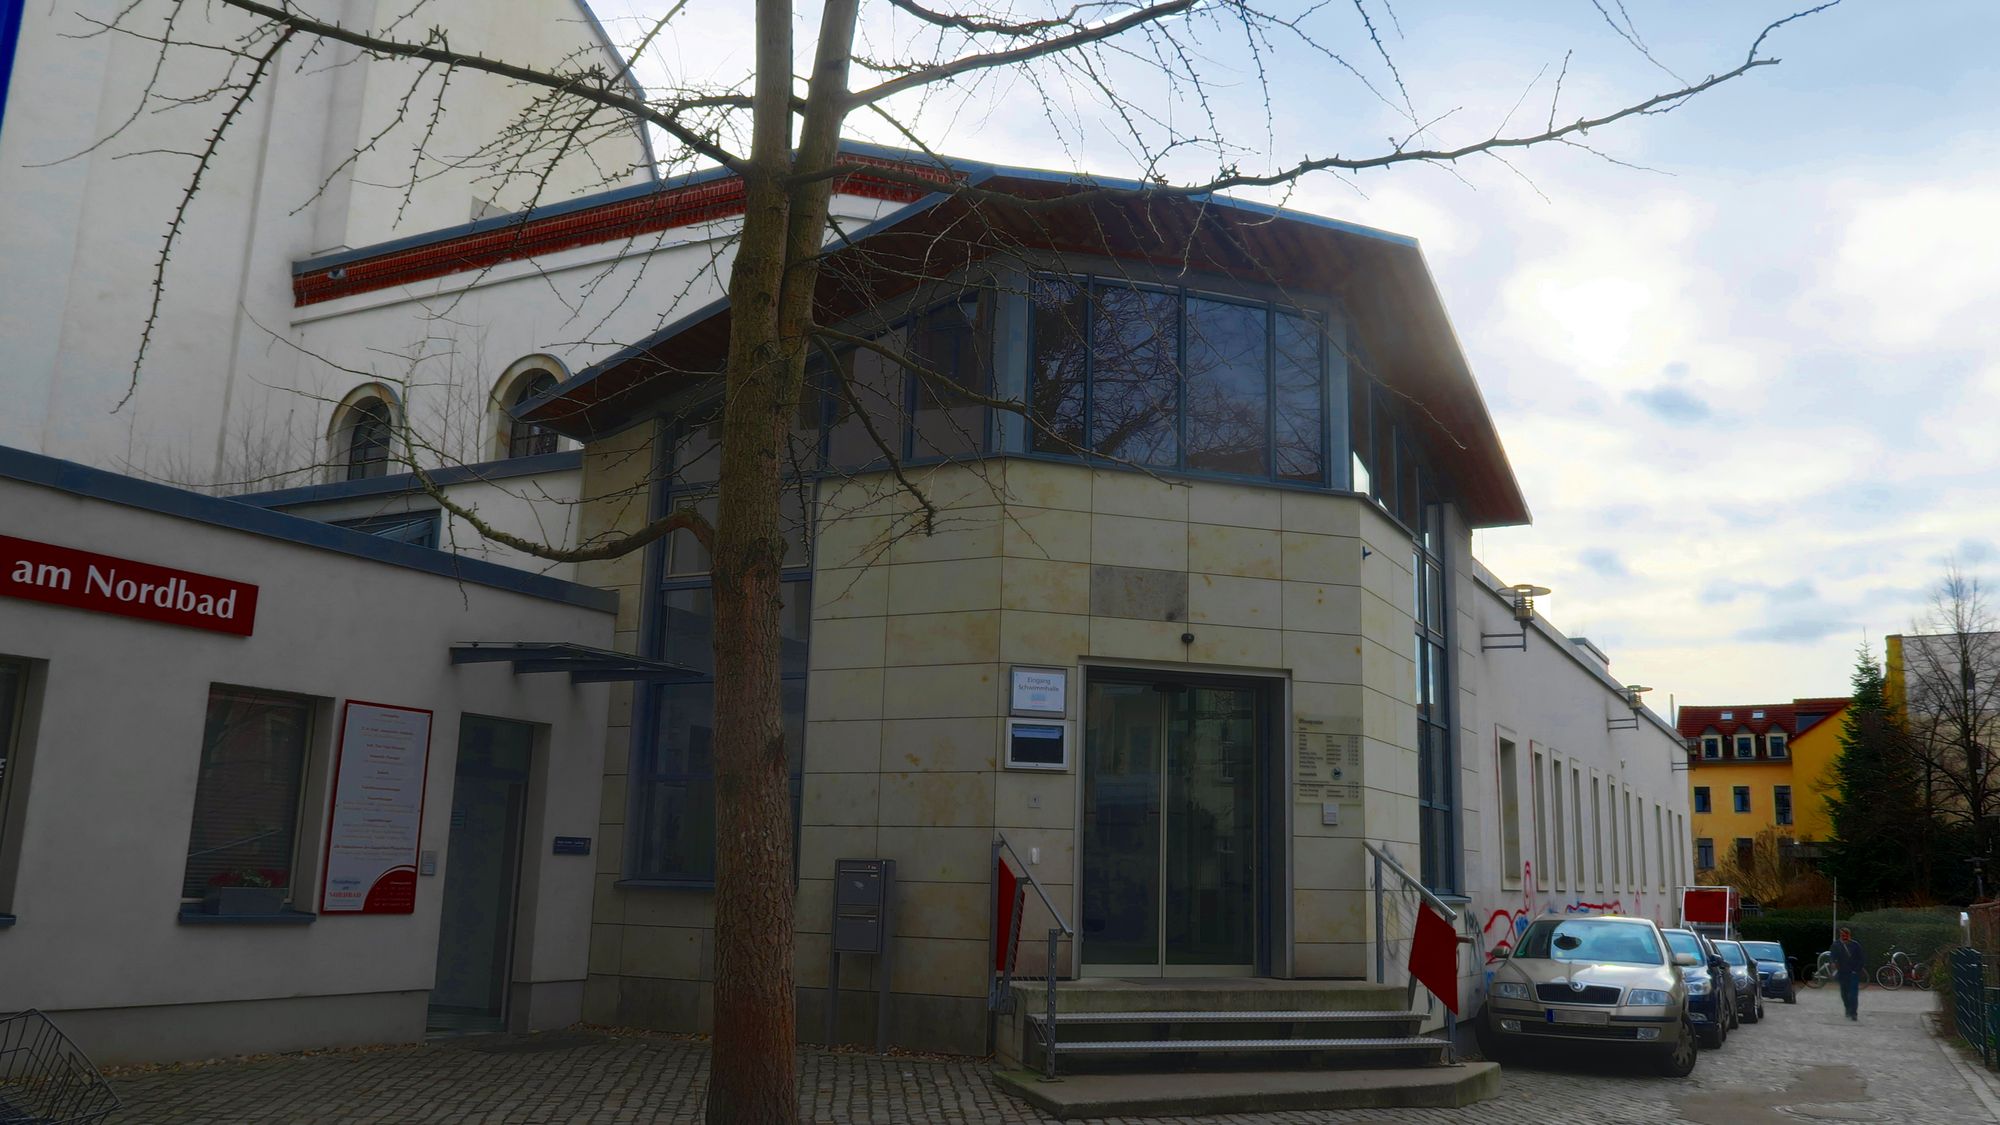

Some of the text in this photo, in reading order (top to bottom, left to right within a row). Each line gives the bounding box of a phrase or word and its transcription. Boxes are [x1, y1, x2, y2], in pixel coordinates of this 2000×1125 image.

[12, 560, 237, 619] am Nordbad
[1027, 677, 1051, 685] Eingang
